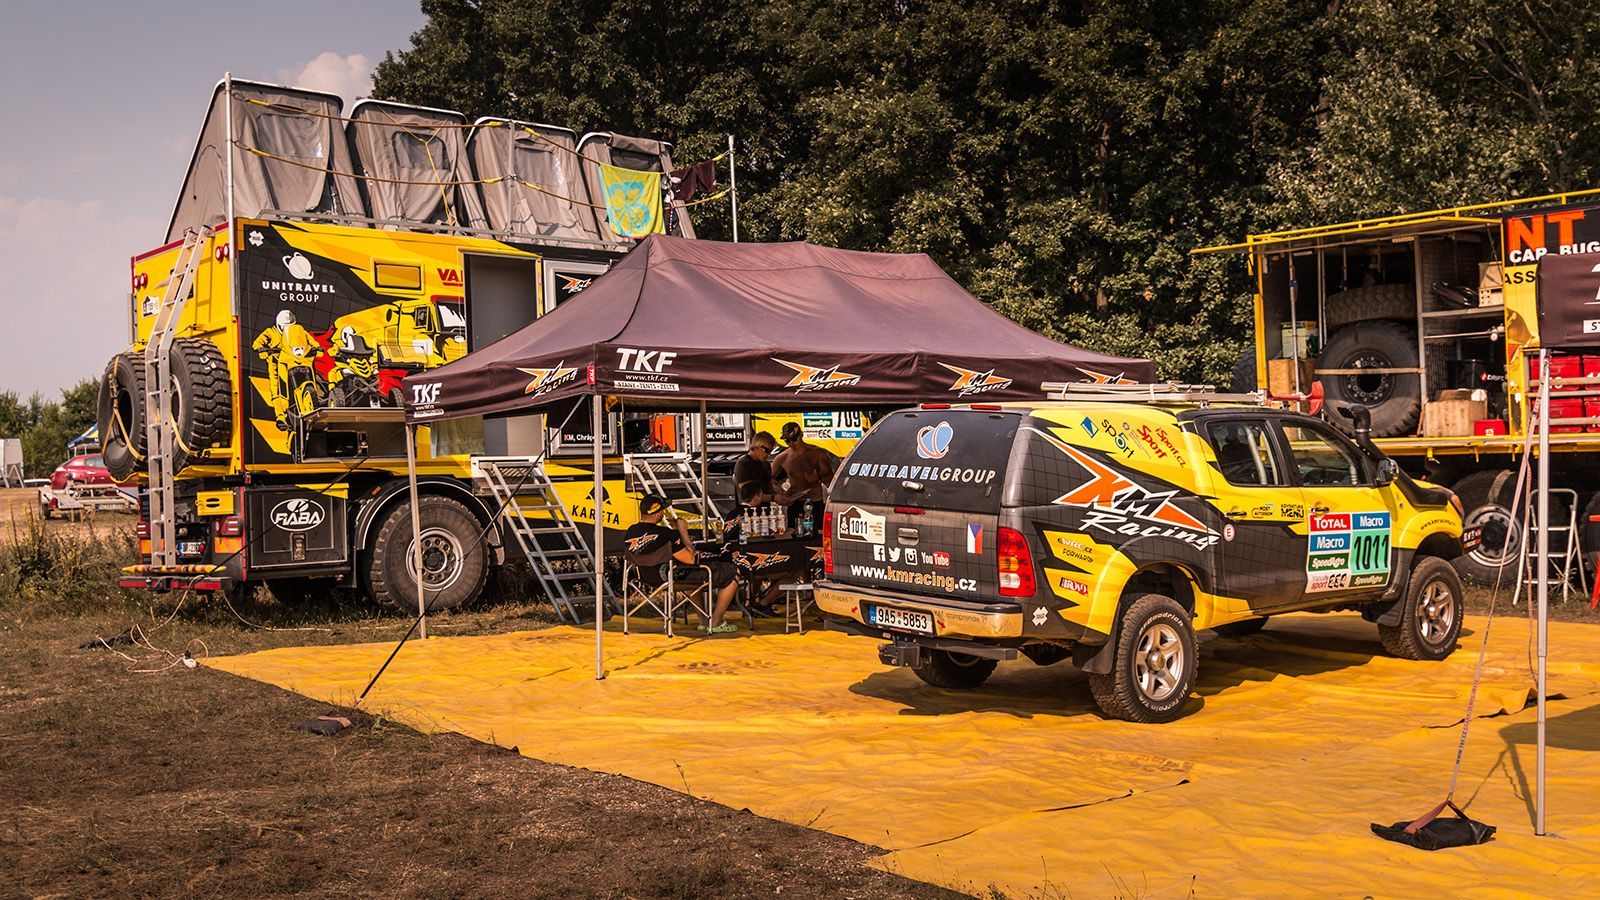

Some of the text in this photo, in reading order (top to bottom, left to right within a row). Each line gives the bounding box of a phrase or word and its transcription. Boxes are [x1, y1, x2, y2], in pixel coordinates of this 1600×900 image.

[437, 268, 463, 282] VA
[262, 281, 336, 293] UNITRAVEL
[280, 292, 319, 302] GROUP
[617, 348, 677, 372] TKF
[625, 374, 668, 382] www.tkf.cz
[795, 377, 861, 395] Racing
[412, 383, 442, 403] TKF
[958, 379, 1013, 398] Racing
[1137, 425, 1168, 459] Sport
[572, 505, 620, 525] KARTA
[1360, 515, 1384, 527] Macro
[850, 520, 868, 535] 1011
[1078, 510, 1222, 551] Racing
[1316, 536, 1345, 549] Macro
[1354, 534, 1390, 571] 1011
[850, 564, 977, 592] www.kmracing.cz
[878, 608, 928, 629] 9A5 5853
